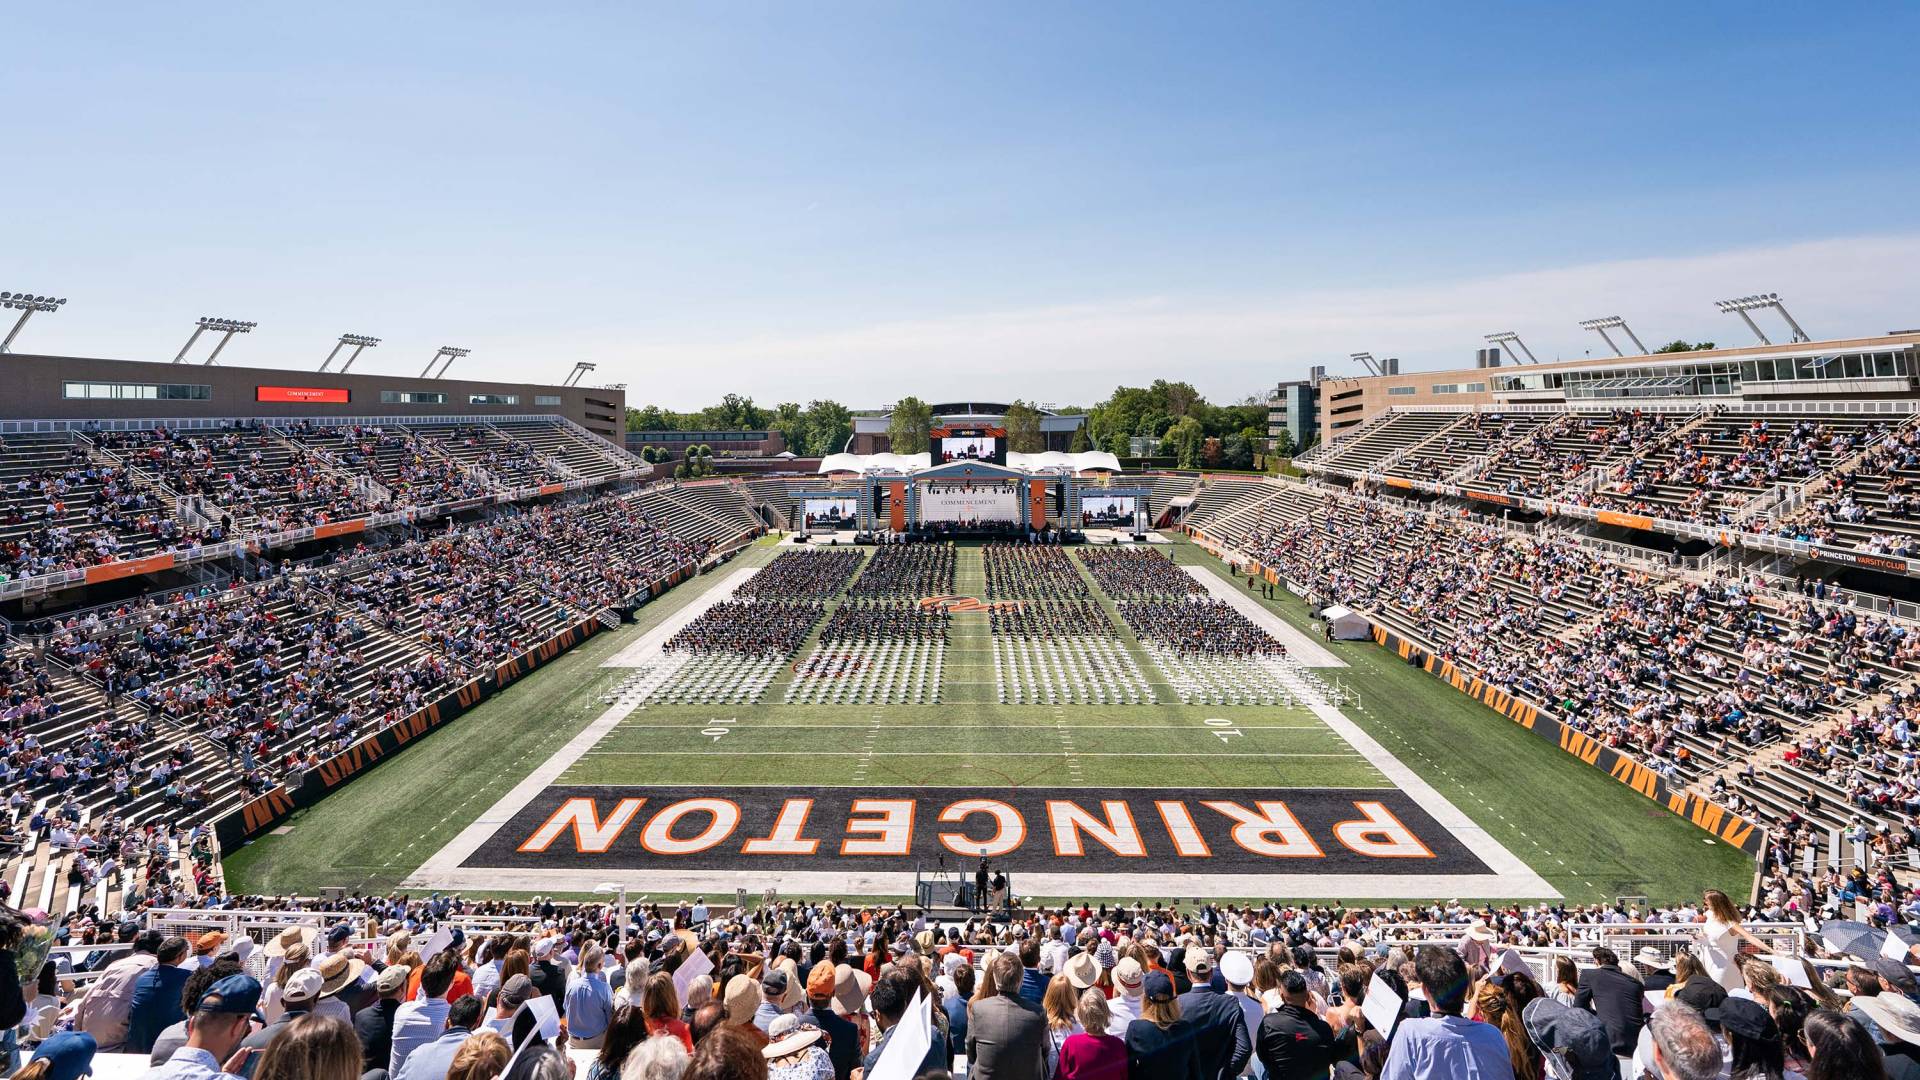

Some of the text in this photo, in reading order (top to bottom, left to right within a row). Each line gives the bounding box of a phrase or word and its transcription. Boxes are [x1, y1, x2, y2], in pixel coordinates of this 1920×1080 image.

[1819, 549, 1906, 571] PRINCETON VARSITY CLUB
[701, 717, 737, 736] 10
[1203, 718, 1244, 737] 10
[516, 798, 1437, 858] PRINCETON
[248, 930, 259, 940] 17
[1674, 943, 1686, 953] 16
